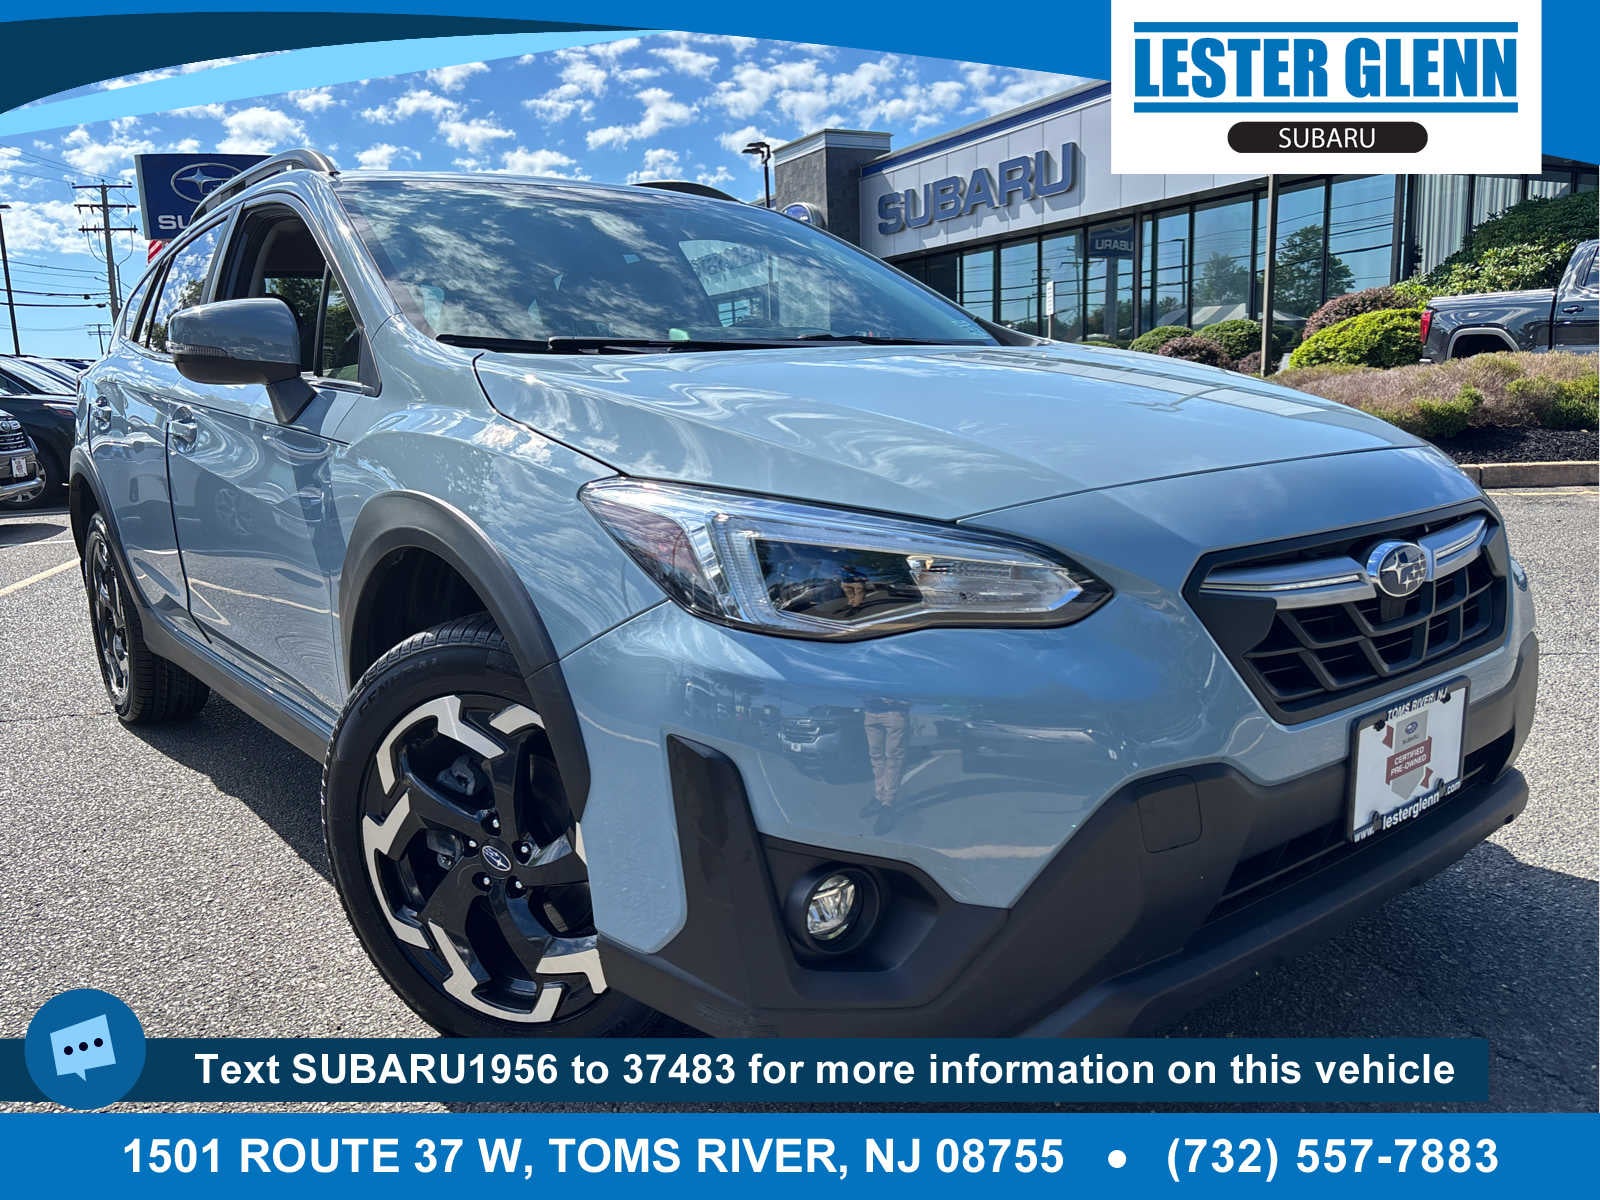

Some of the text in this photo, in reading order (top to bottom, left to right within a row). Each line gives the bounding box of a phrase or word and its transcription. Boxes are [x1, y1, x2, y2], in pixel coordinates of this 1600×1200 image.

[878, 142, 1077, 235] SUBARU
[1388, 702, 1410, 720] TOMS
[1390, 754, 1427, 776] PRE-OWNED
[1394, 746, 1424, 765] CERTIFIED
